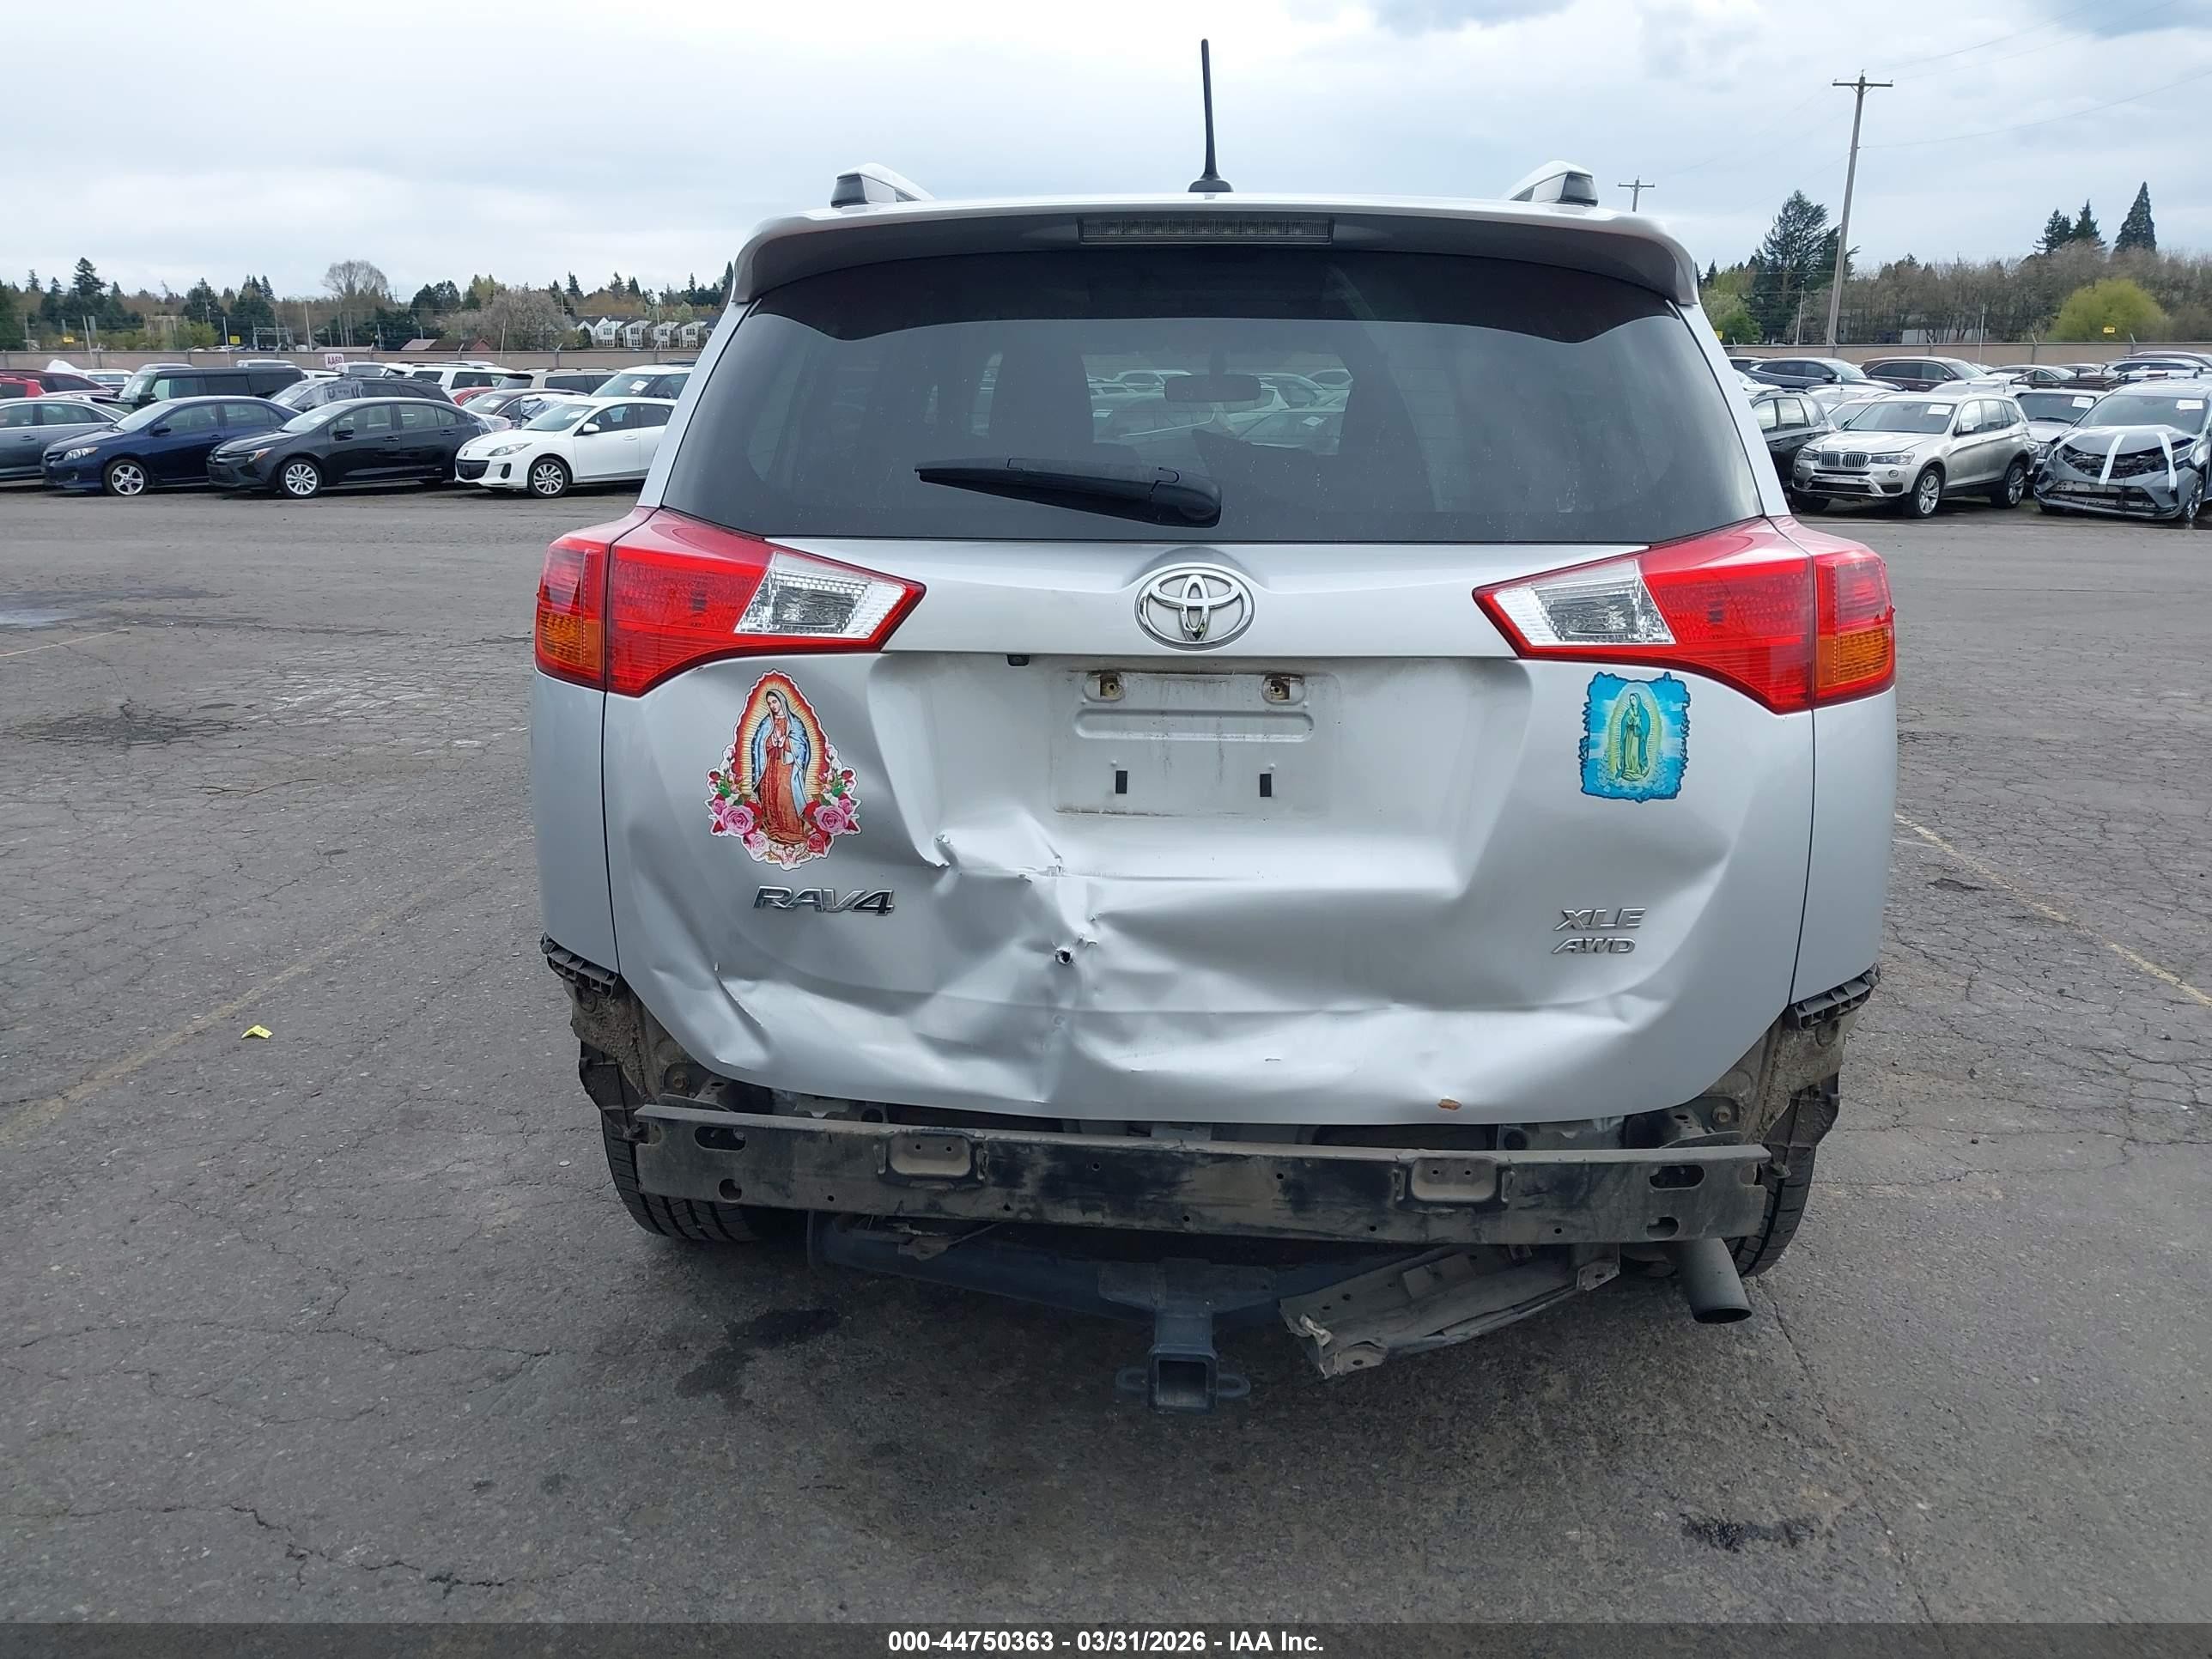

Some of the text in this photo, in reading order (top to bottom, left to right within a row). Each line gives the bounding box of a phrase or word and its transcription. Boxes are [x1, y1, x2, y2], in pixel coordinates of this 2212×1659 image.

[752, 885, 895, 916] RAV4
[1553, 907, 1647, 931] XLE
[1551, 937, 1636, 954] AWD
